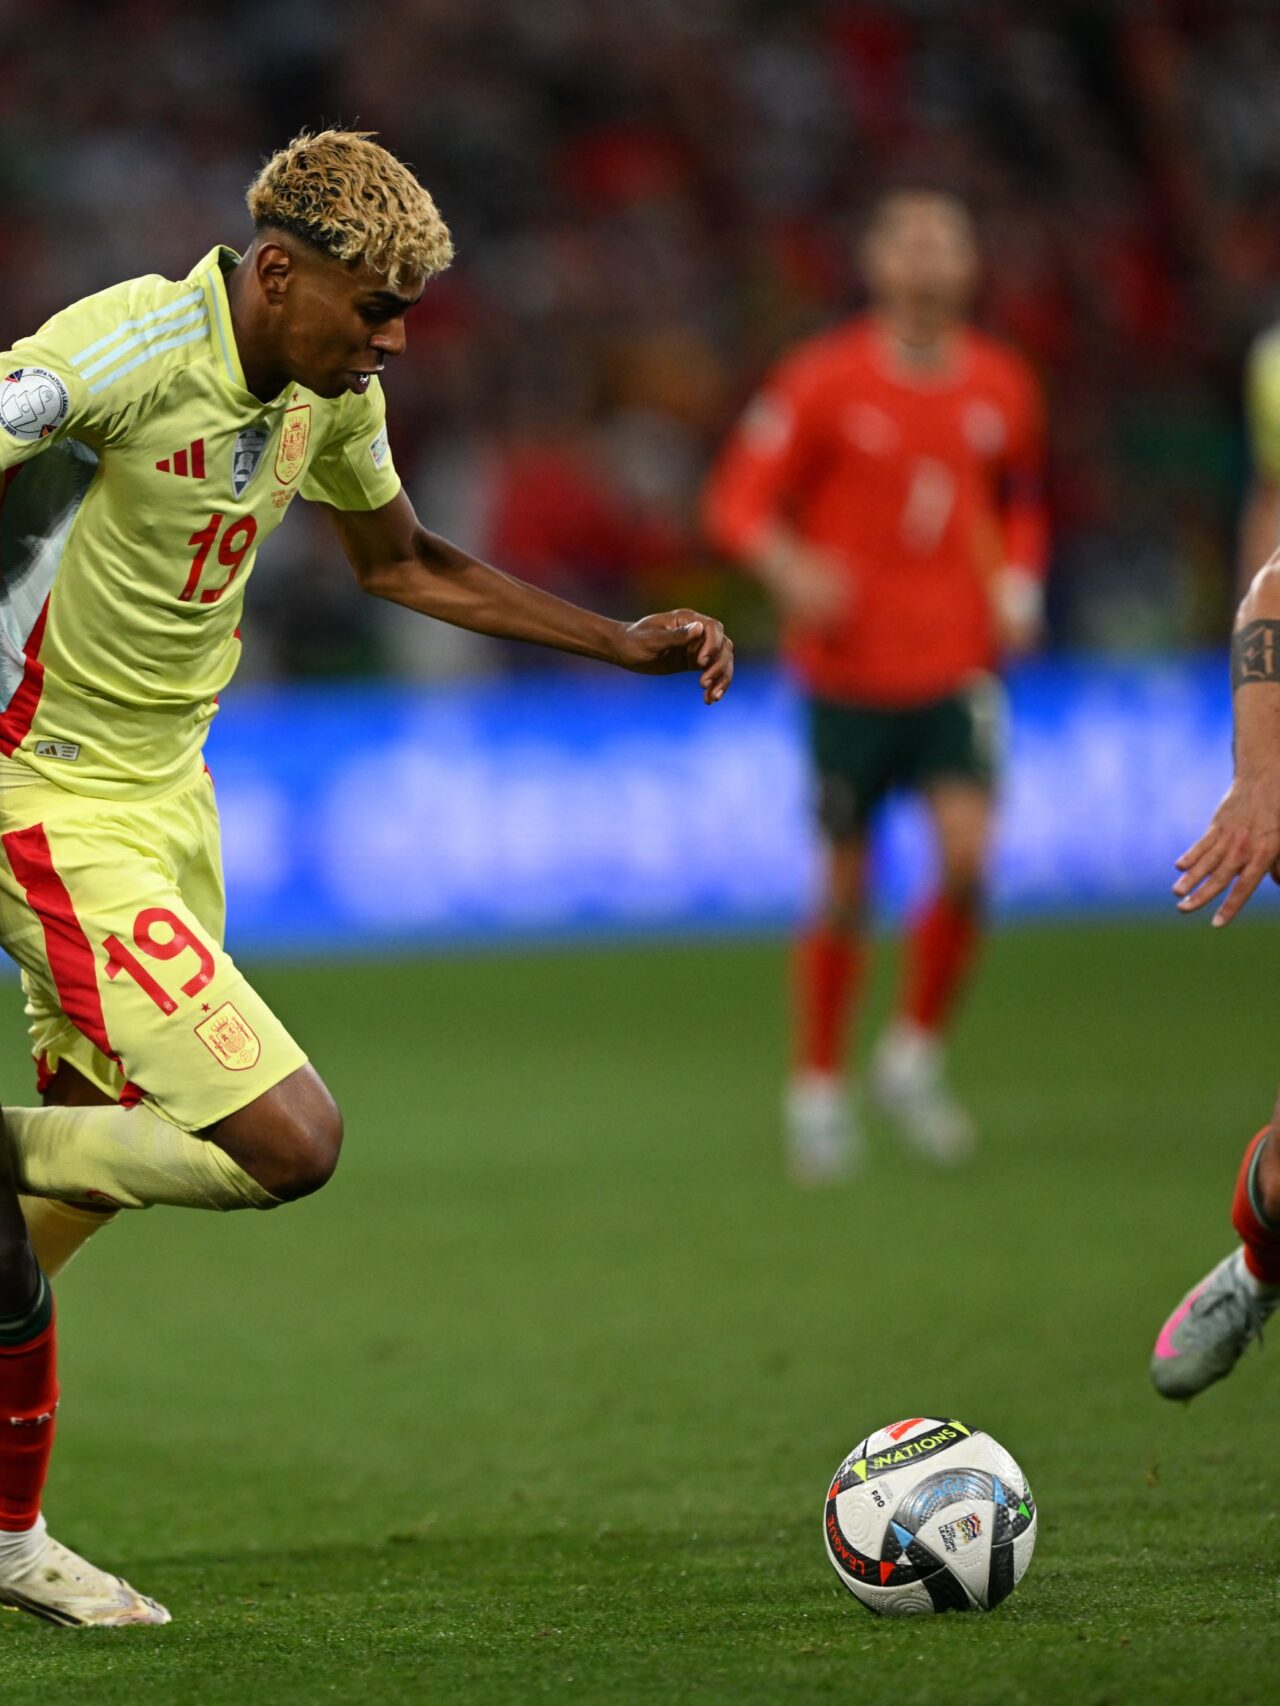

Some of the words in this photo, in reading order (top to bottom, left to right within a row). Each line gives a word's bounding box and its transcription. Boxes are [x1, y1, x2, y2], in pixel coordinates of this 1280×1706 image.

[32, 368, 47, 376] UEFA
[48, 374, 67, 396] NATIONS
[178, 513, 257, 604] 19
[101, 907, 215, 1016] 19
[879, 1428, 958, 1468] NATIONS
[871, 1490, 885, 1508] PRO
[827, 1514, 865, 1576] LEAGUE
[944, 1524, 957, 1552] NATIONS
